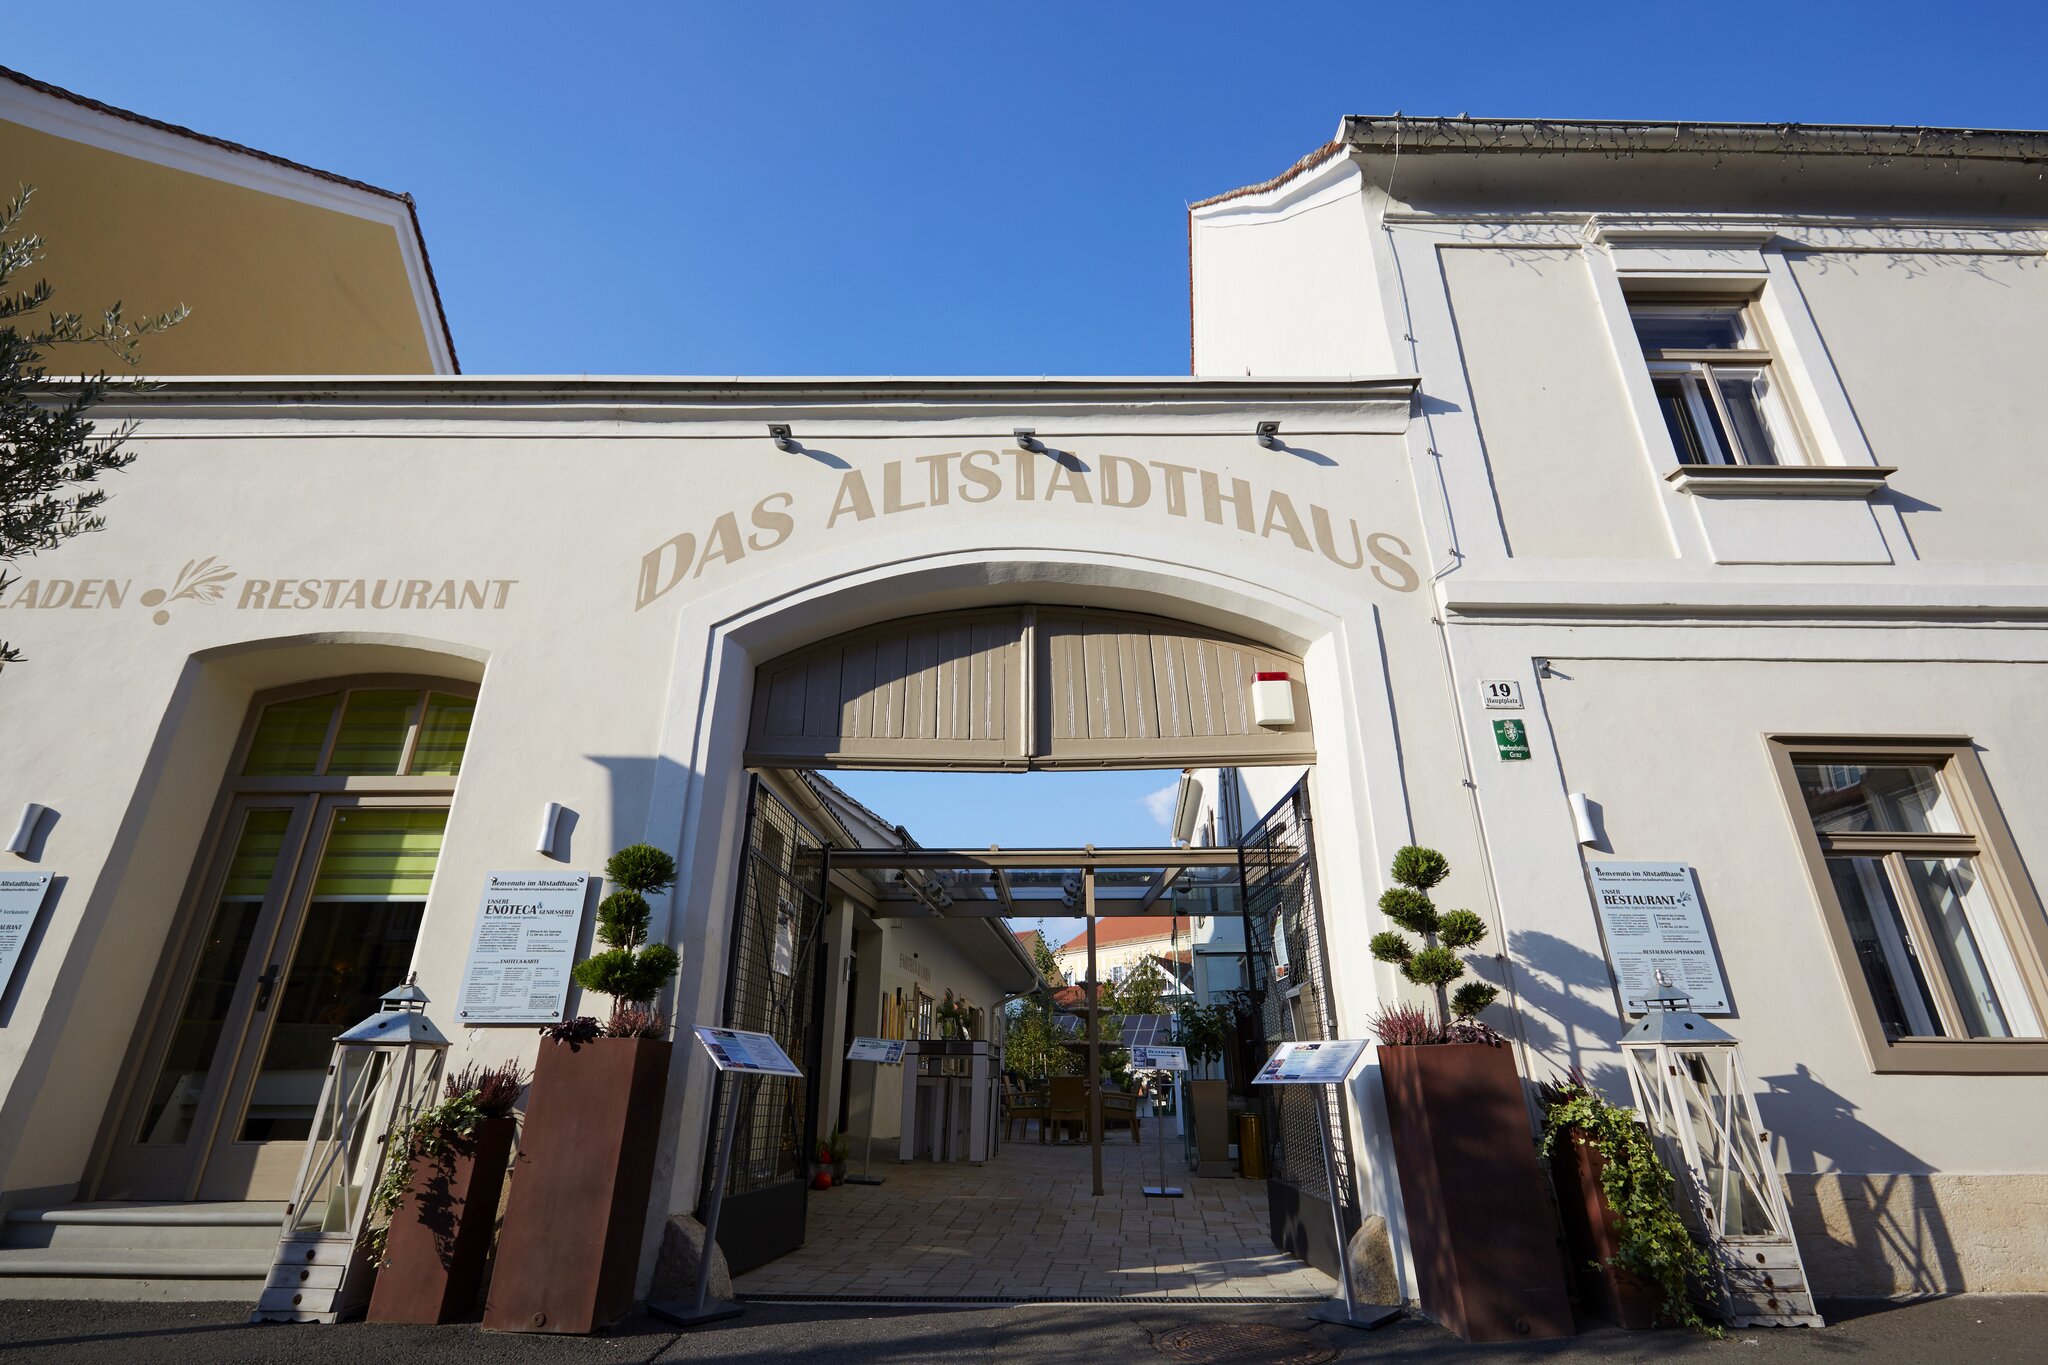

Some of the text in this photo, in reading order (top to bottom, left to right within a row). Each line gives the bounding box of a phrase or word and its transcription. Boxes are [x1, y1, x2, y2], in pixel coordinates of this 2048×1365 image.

[635, 449, 1420, 612] DAS ALTSTADTHAUS
[236, 579, 519, 610] RESTAURANT
[1489, 683, 1511, 697] 19
[1604, 895, 1675, 905] RESTAURANT
[485, 904, 537, 915] ENOTECA
